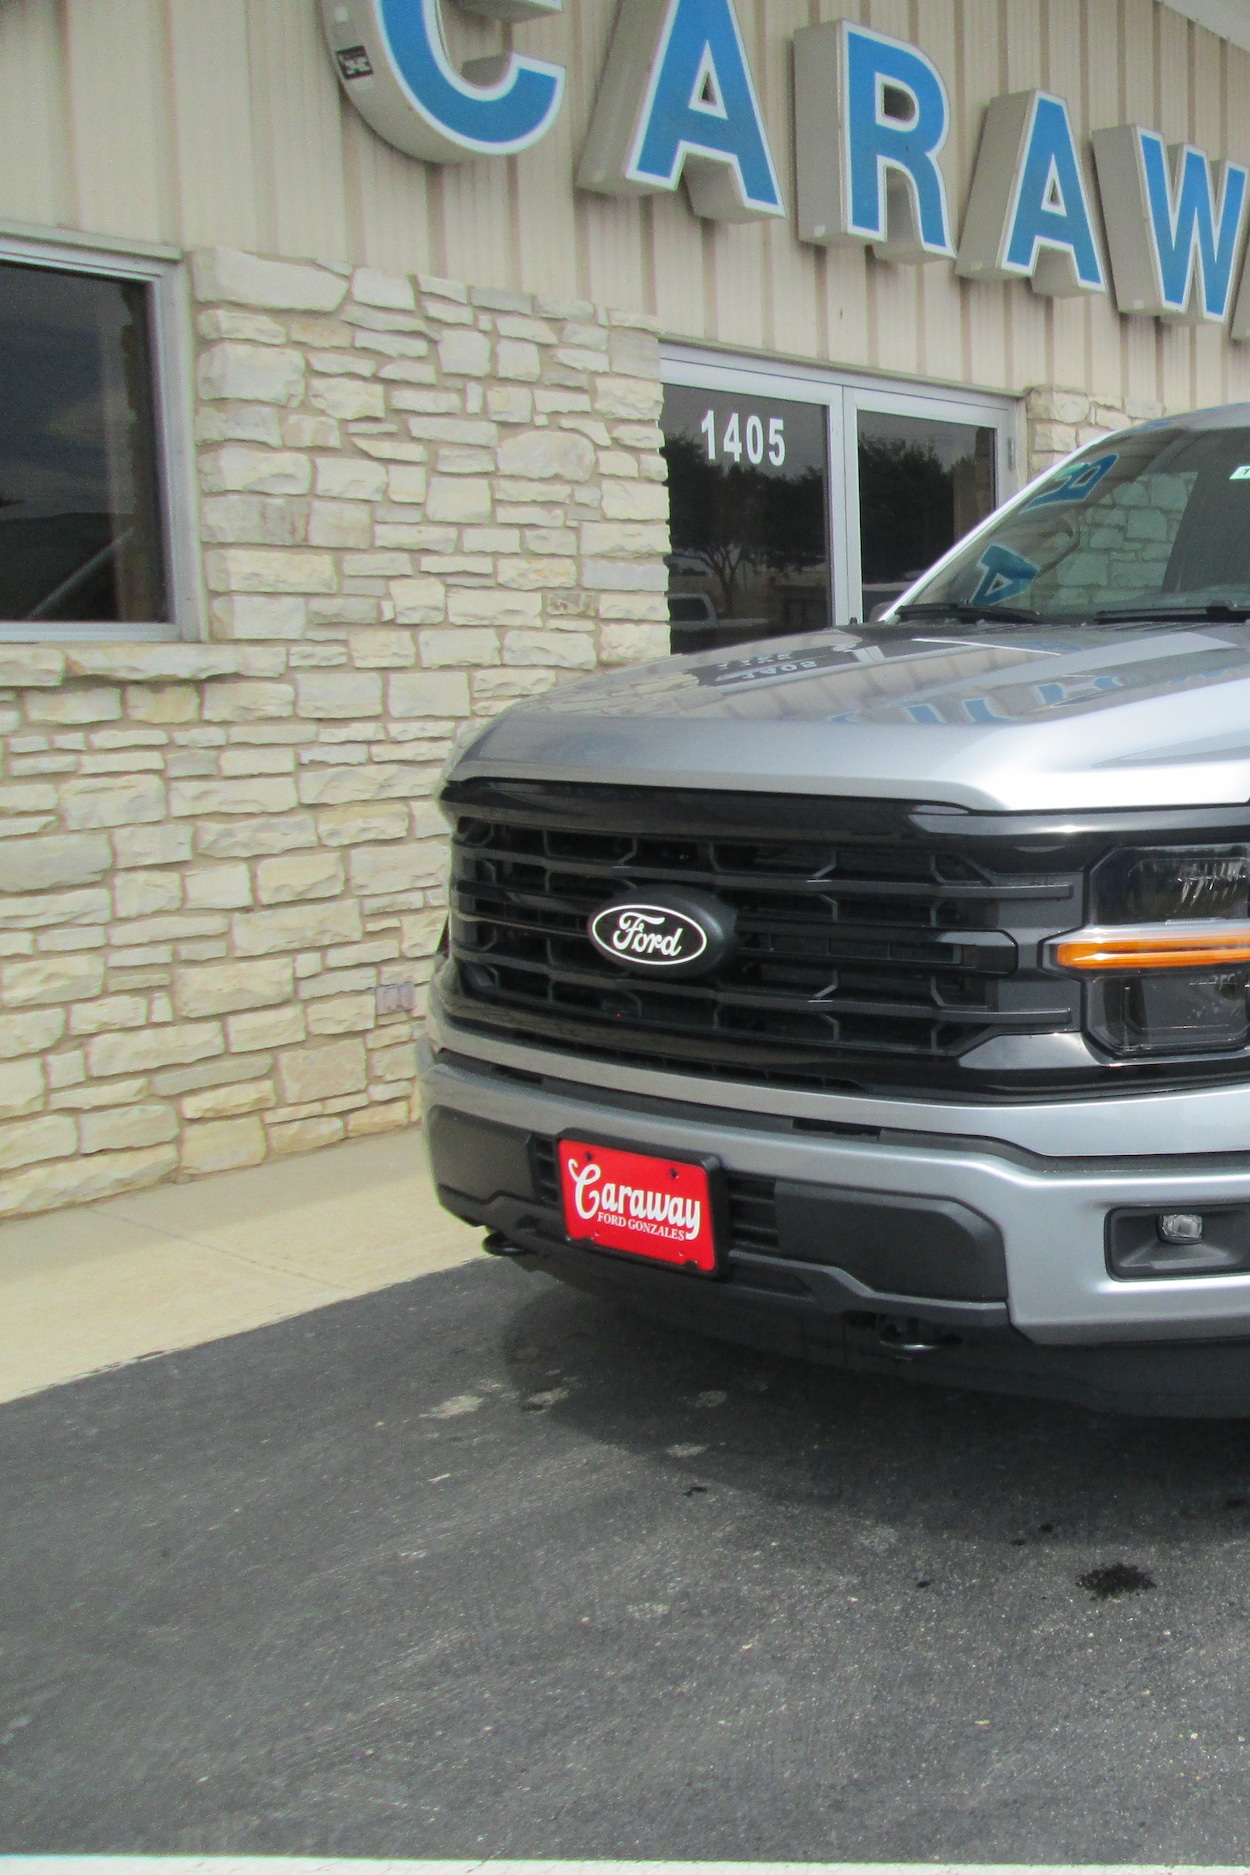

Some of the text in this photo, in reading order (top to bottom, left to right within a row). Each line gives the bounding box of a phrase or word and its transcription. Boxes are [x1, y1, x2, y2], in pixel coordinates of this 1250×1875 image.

[701, 409, 786, 467] 1405
[613, 911, 683, 957] Ford
[568, 1158, 701, 1241] Caraway
[597, 1211, 685, 1242] FORD GONZALES
